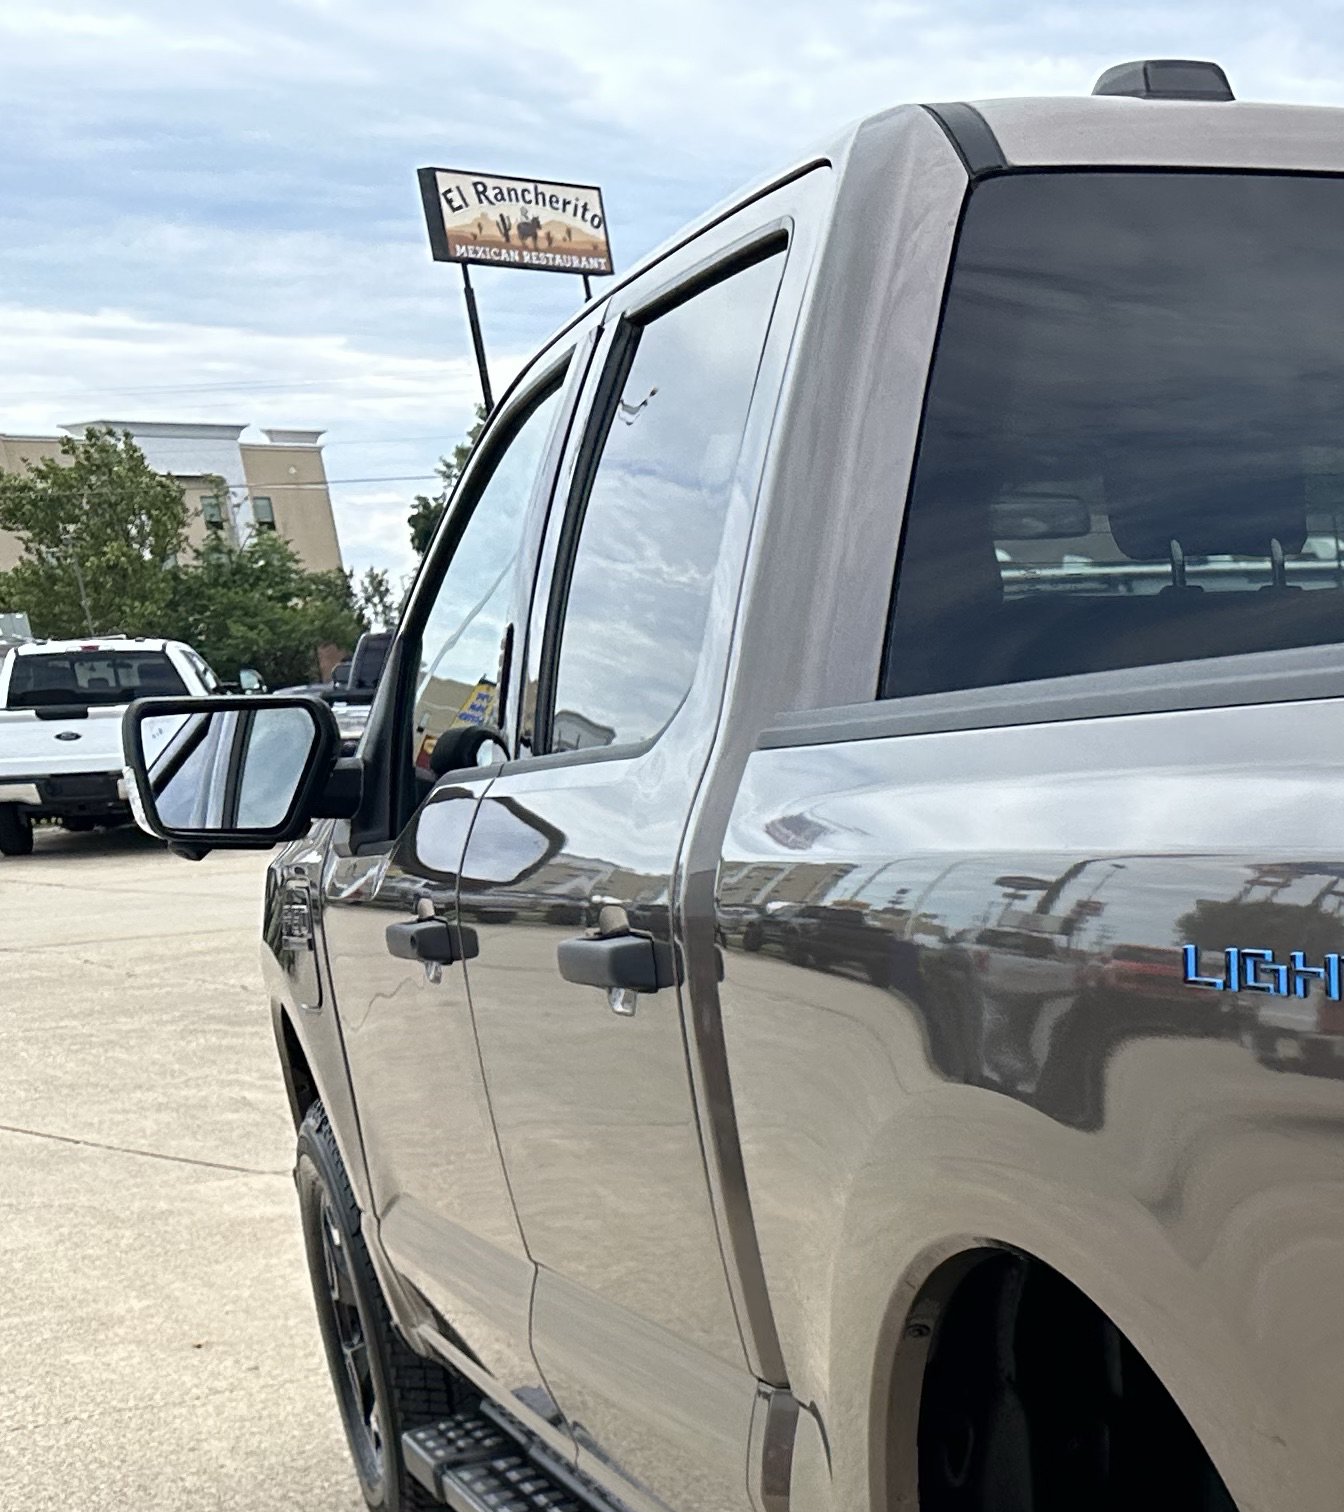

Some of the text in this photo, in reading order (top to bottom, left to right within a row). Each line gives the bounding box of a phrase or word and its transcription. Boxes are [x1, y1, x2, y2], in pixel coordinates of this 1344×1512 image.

[441, 181, 603, 230] El Rancherito
[455, 244, 608, 271] MEXICAN RESTAURANT
